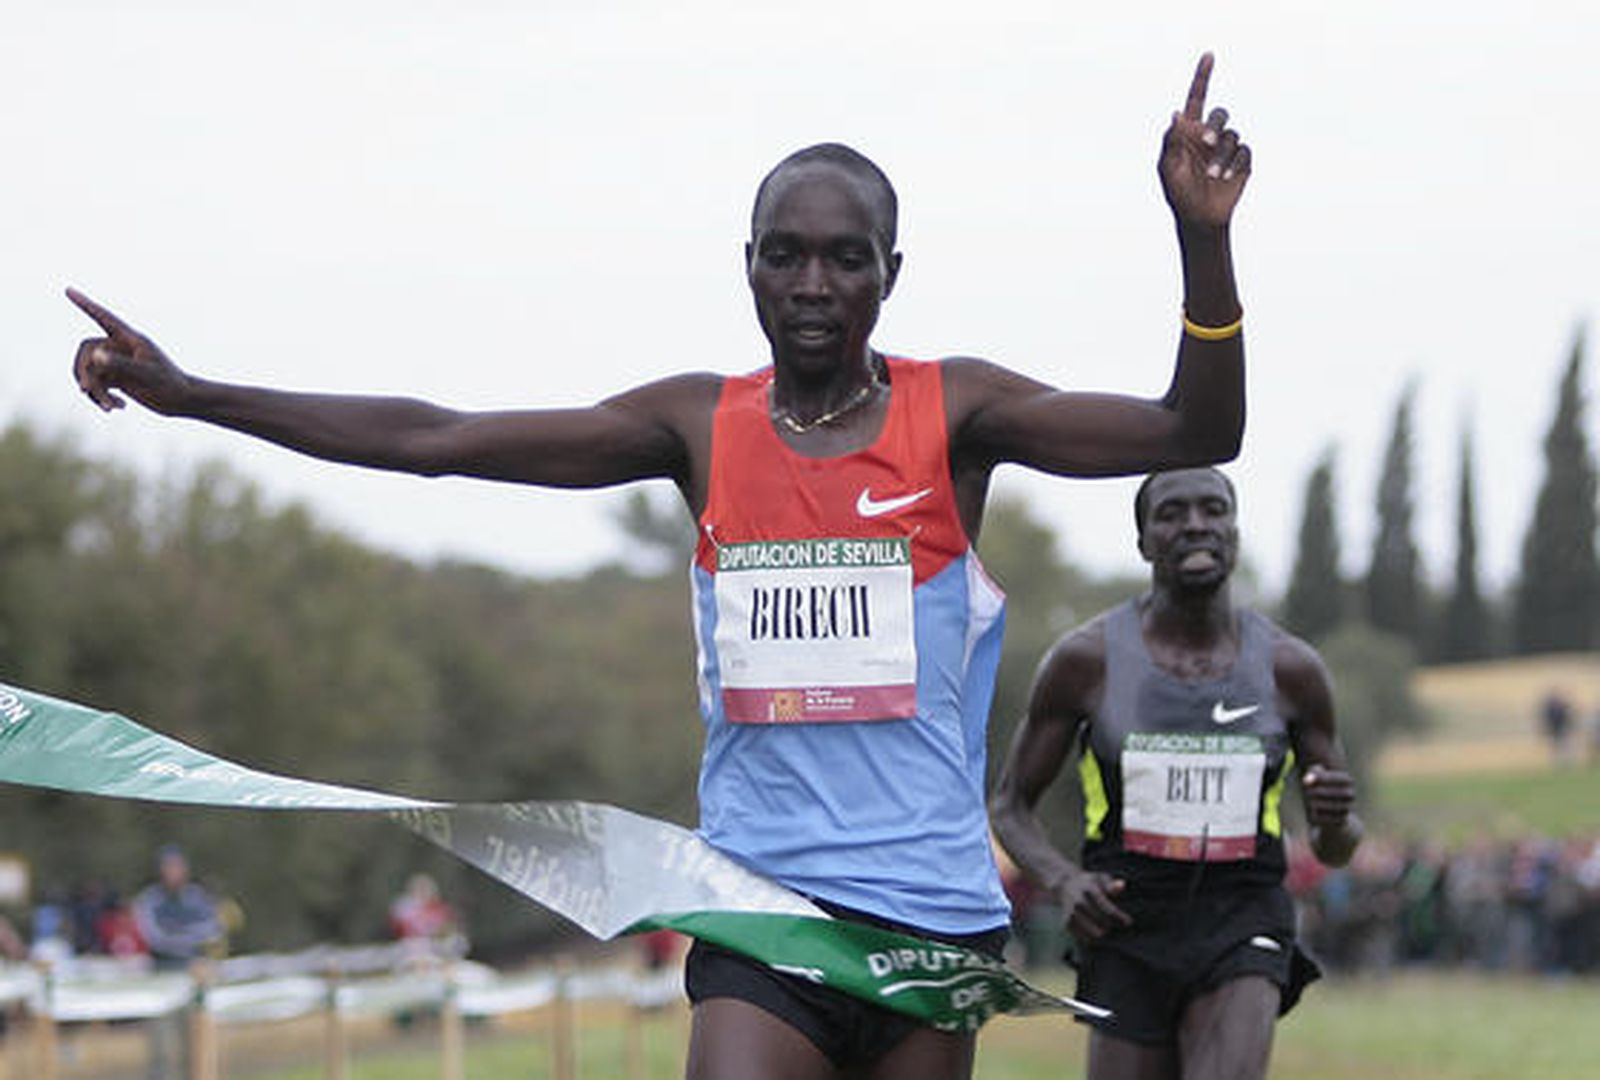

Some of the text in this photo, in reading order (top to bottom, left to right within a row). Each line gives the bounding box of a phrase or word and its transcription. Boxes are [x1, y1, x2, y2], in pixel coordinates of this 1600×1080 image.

[720, 541, 905, 569] DIPUTACION DE SEVILLA
[750, 585, 871, 640] BIRECH
[1166, 765, 1229, 802] BETT
